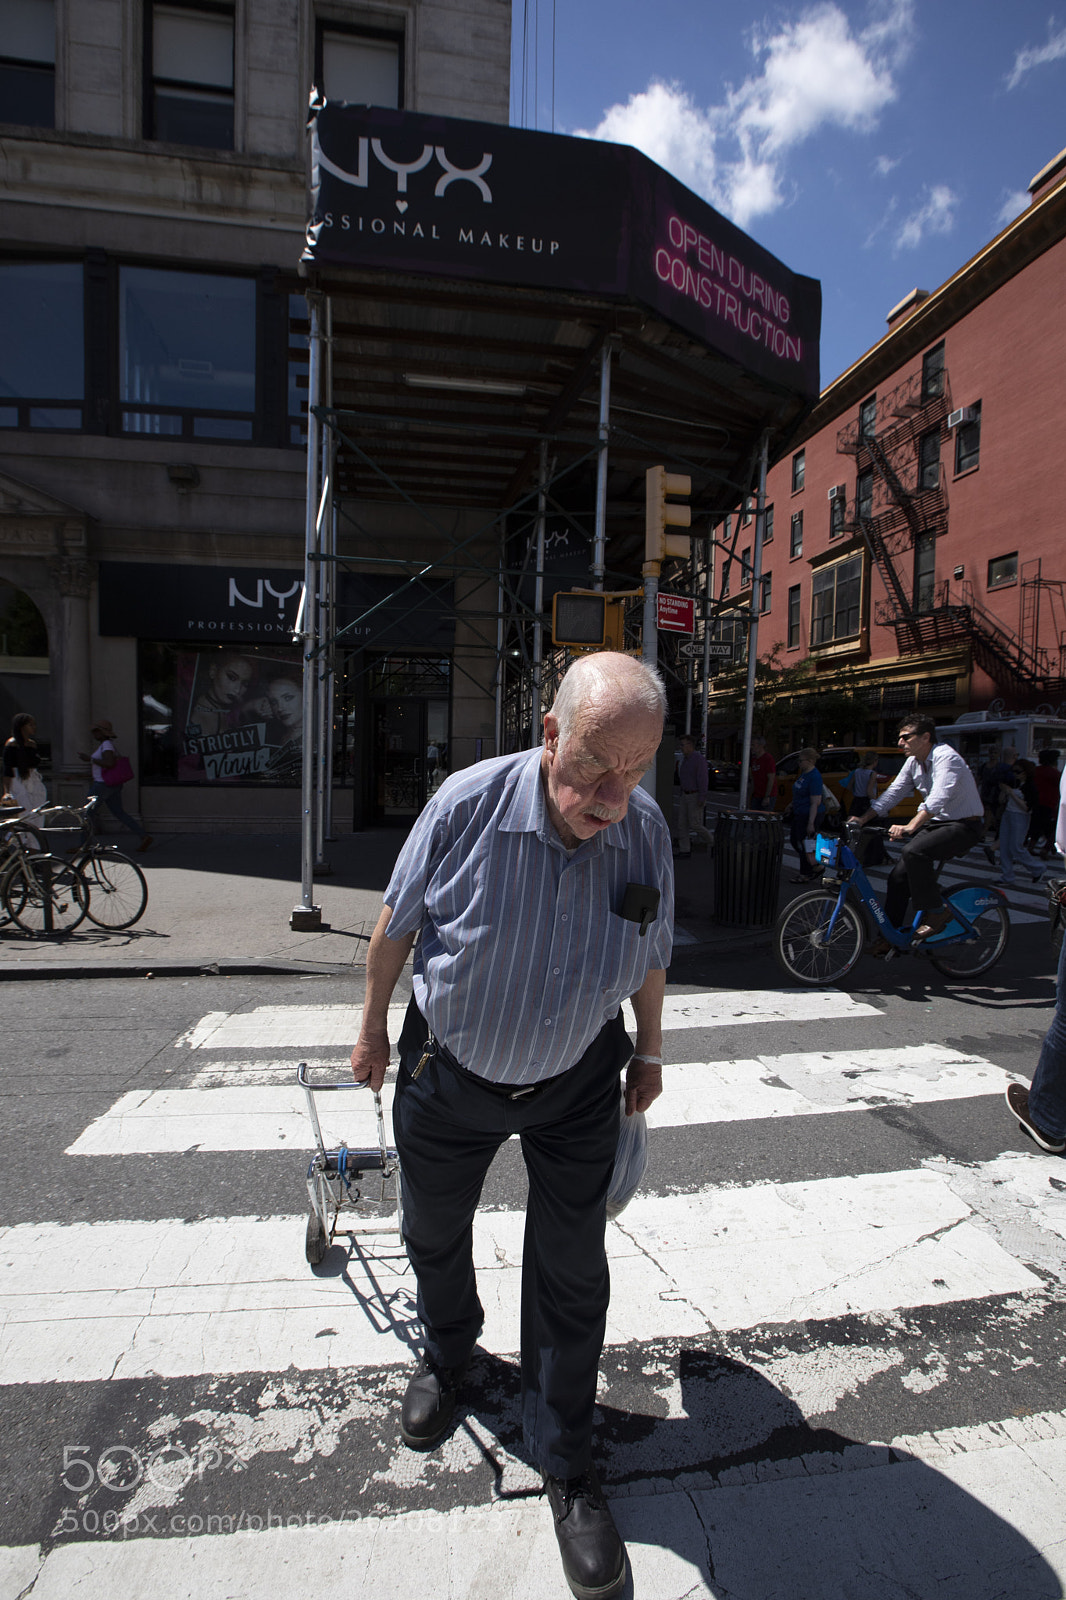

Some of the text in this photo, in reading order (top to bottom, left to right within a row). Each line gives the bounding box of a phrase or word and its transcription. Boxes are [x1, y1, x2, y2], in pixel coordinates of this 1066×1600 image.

[458, 227, 561, 256] MAKEUP
[668, 214, 792, 324] OPEN DURING
[654, 247, 802, 363] CONSTRUCTION
[659, 605, 678, 615] Anytime
[667, 598, 688, 609] STANDING
[686, 645, 729, 654] ONE WAY
[188, 729, 255, 754] STRICTLY
[207, 750, 260, 778] Vinyl
